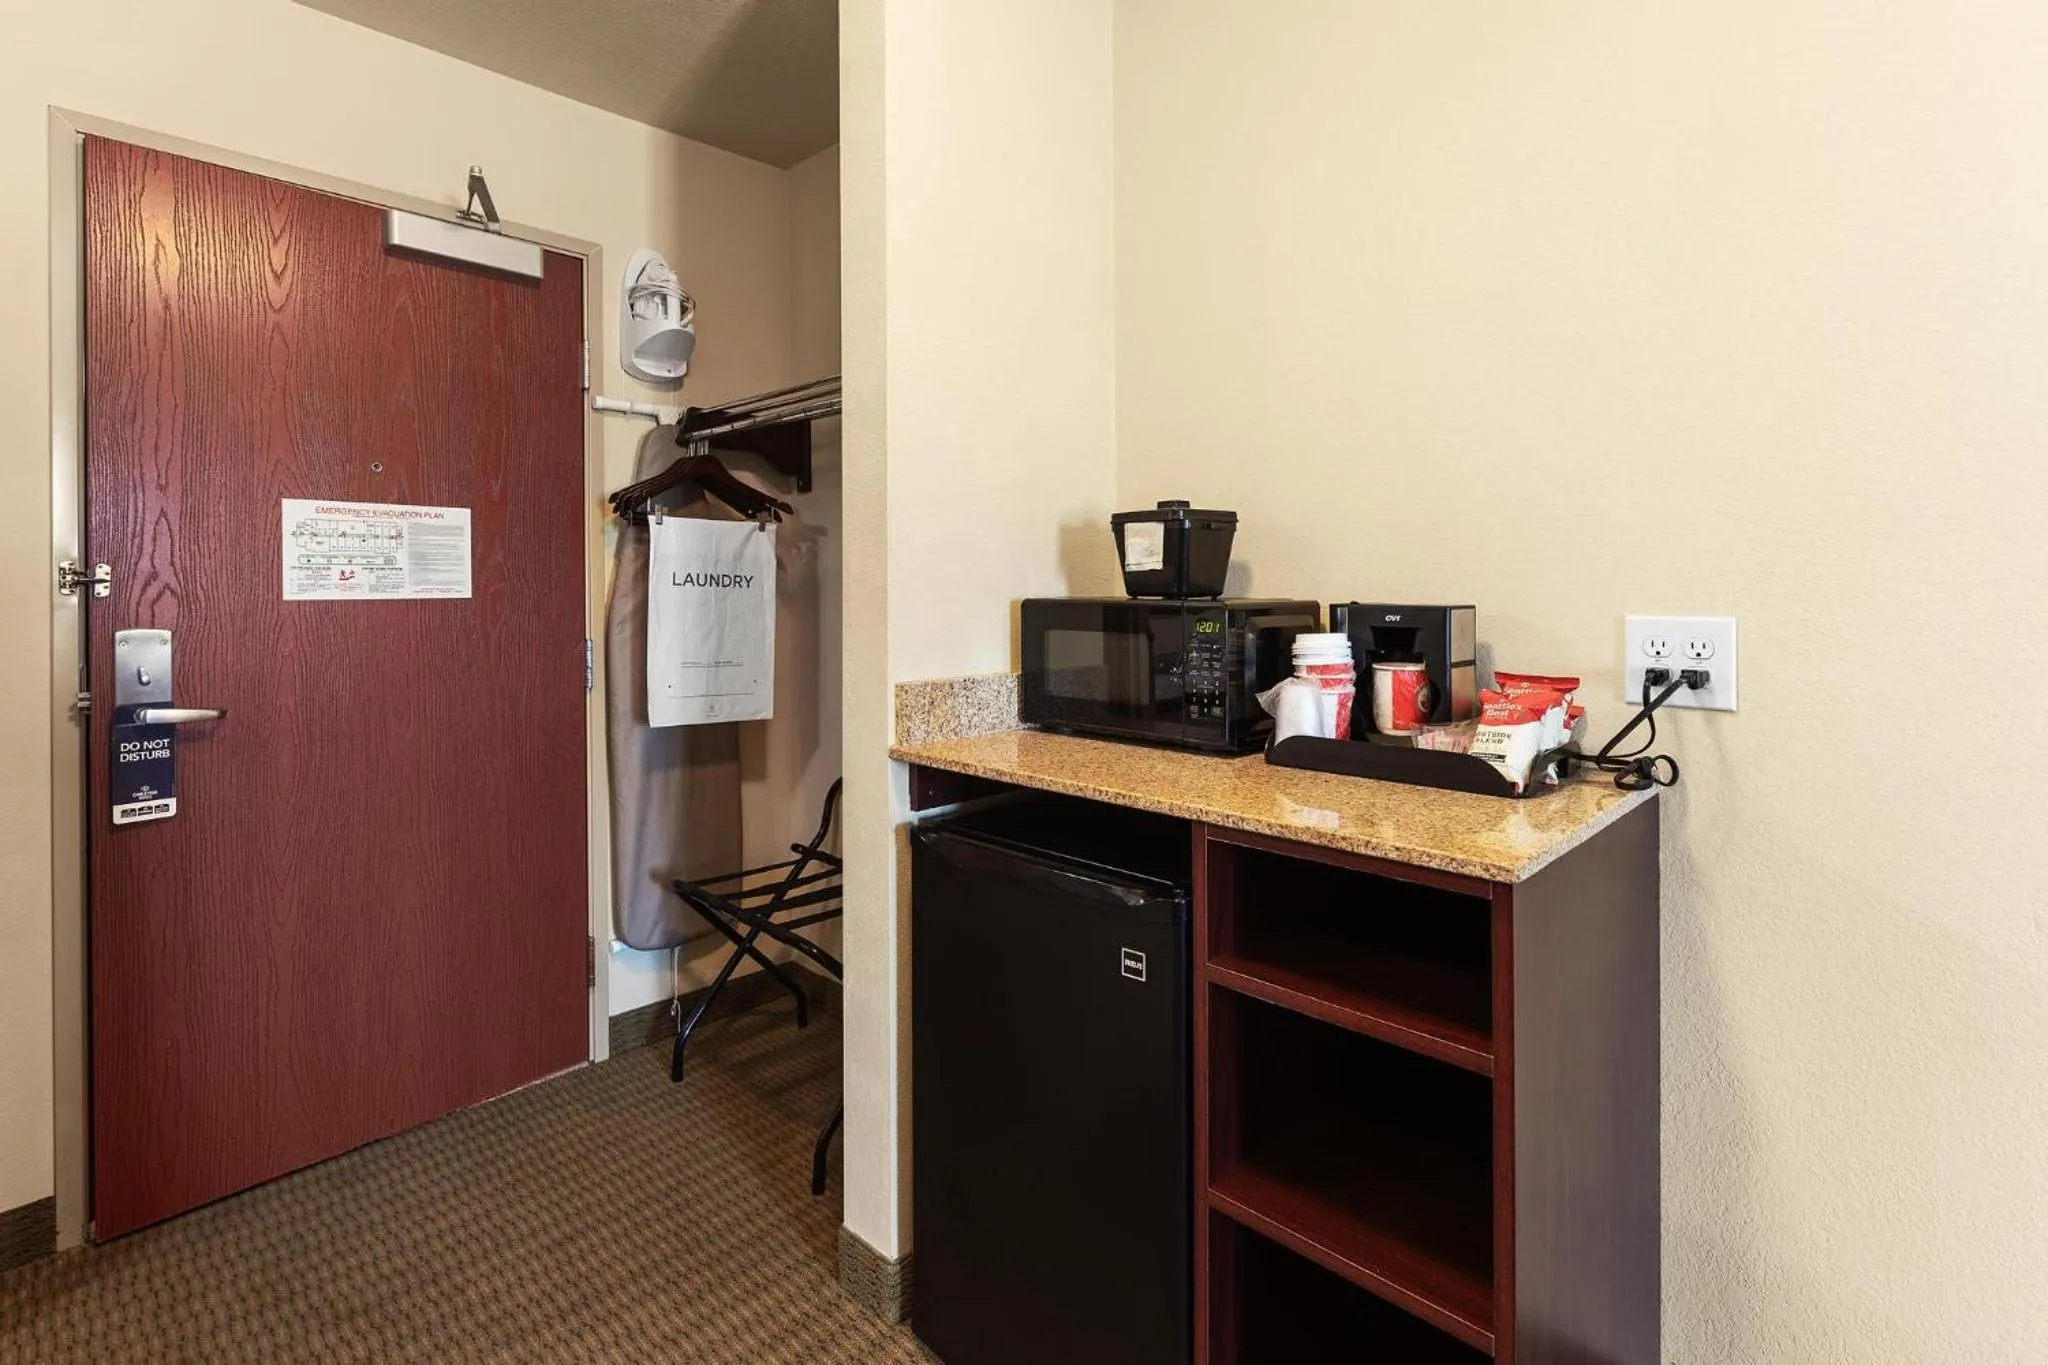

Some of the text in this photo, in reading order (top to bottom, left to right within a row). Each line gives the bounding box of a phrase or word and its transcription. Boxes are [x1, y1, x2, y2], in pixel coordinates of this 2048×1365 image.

[315, 506, 445, 520] EMERGENCY EVACUATION PLAN
[672, 572, 754, 588] LAUNDRY
[121, 739, 170, 752] DO NOT
[120, 749, 170, 762] DISTURB
